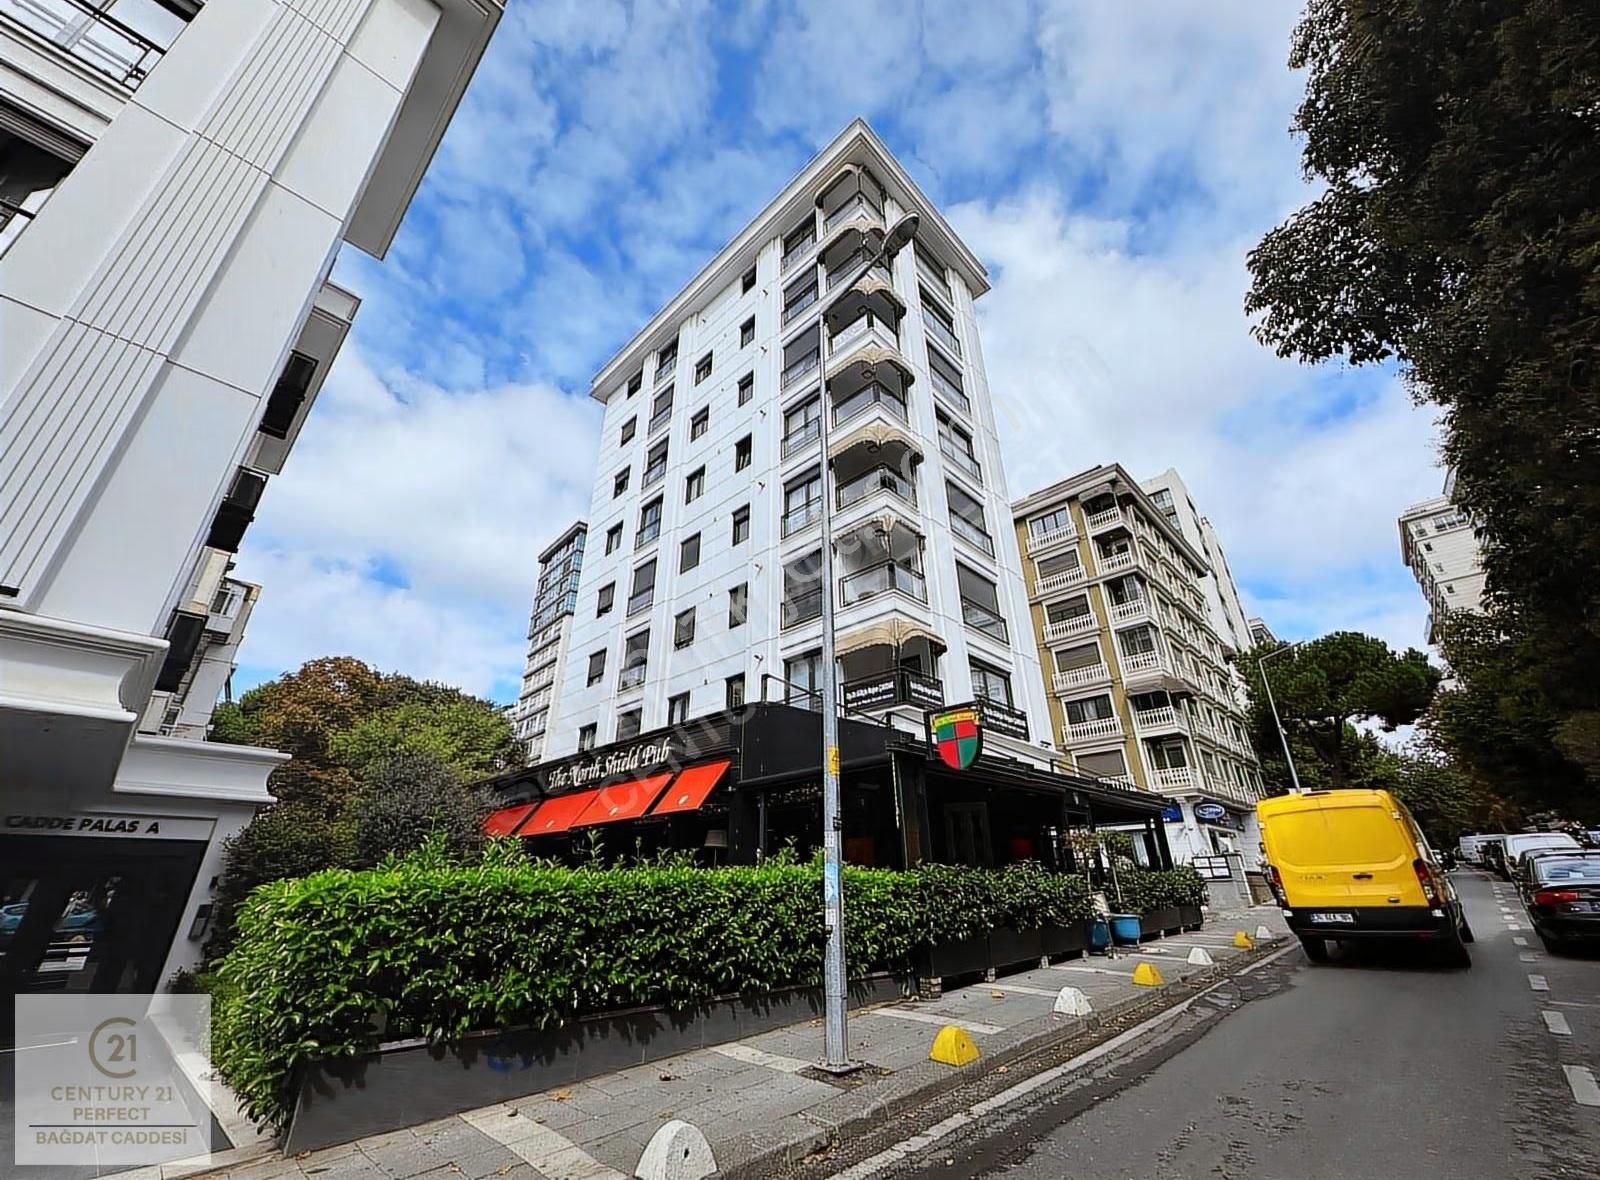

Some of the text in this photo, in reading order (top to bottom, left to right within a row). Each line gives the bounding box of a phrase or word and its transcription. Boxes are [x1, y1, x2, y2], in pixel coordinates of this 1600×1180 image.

[548, 737, 673, 789] The North Shield Pub
[6, 815, 160, 834] CADDE PALAS A
